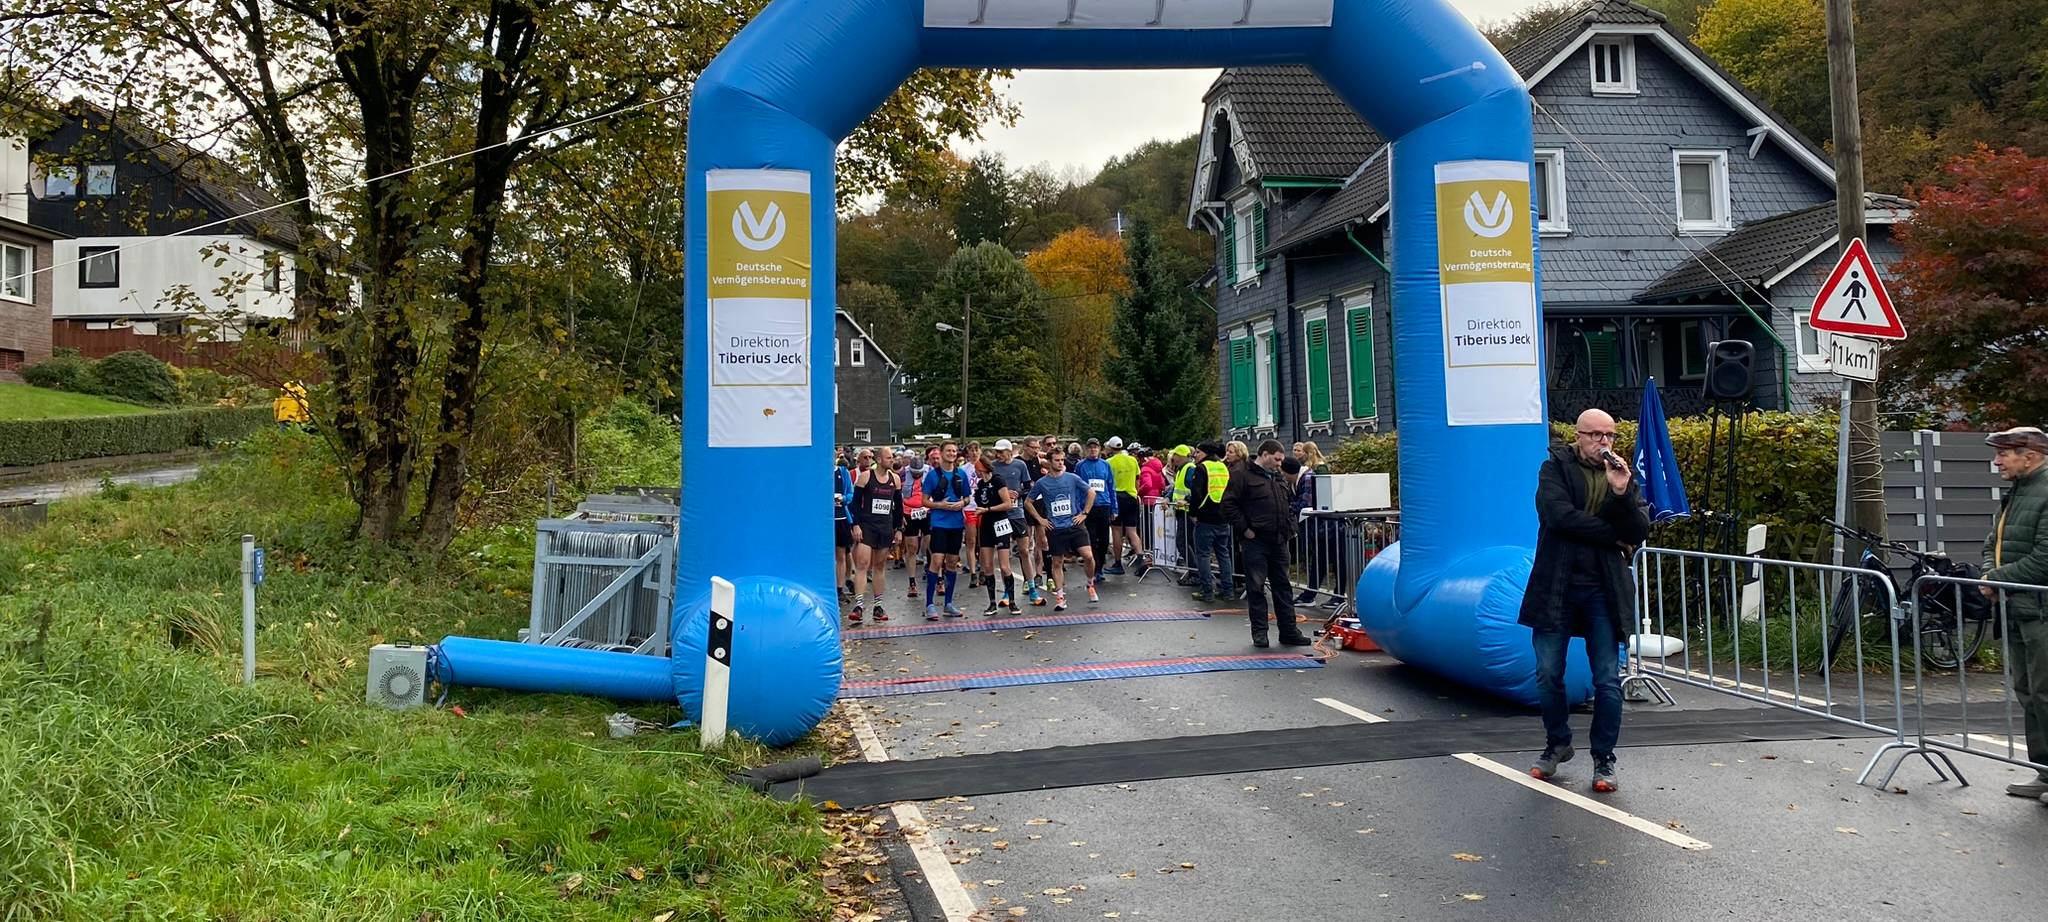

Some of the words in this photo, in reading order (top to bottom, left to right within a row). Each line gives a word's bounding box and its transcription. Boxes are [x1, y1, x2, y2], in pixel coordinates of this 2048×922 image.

[1470, 248, 1512, 258] Deutsche
[736, 262, 783, 272] Deutsche
[1444, 260, 1531, 272] Vermögensberatung
[711, 274, 807, 288] Vermögensberatung
[1467, 318, 1522, 330] Direktion
[730, 335, 790, 348] Direktion
[1454, 334, 1507, 346] Tiberius
[1509, 333, 1531, 345] Jeck
[718, 352, 771, 364] Tiberius
[774, 352, 802, 364] Jeck
[1053, 504, 1070, 513] 4103
